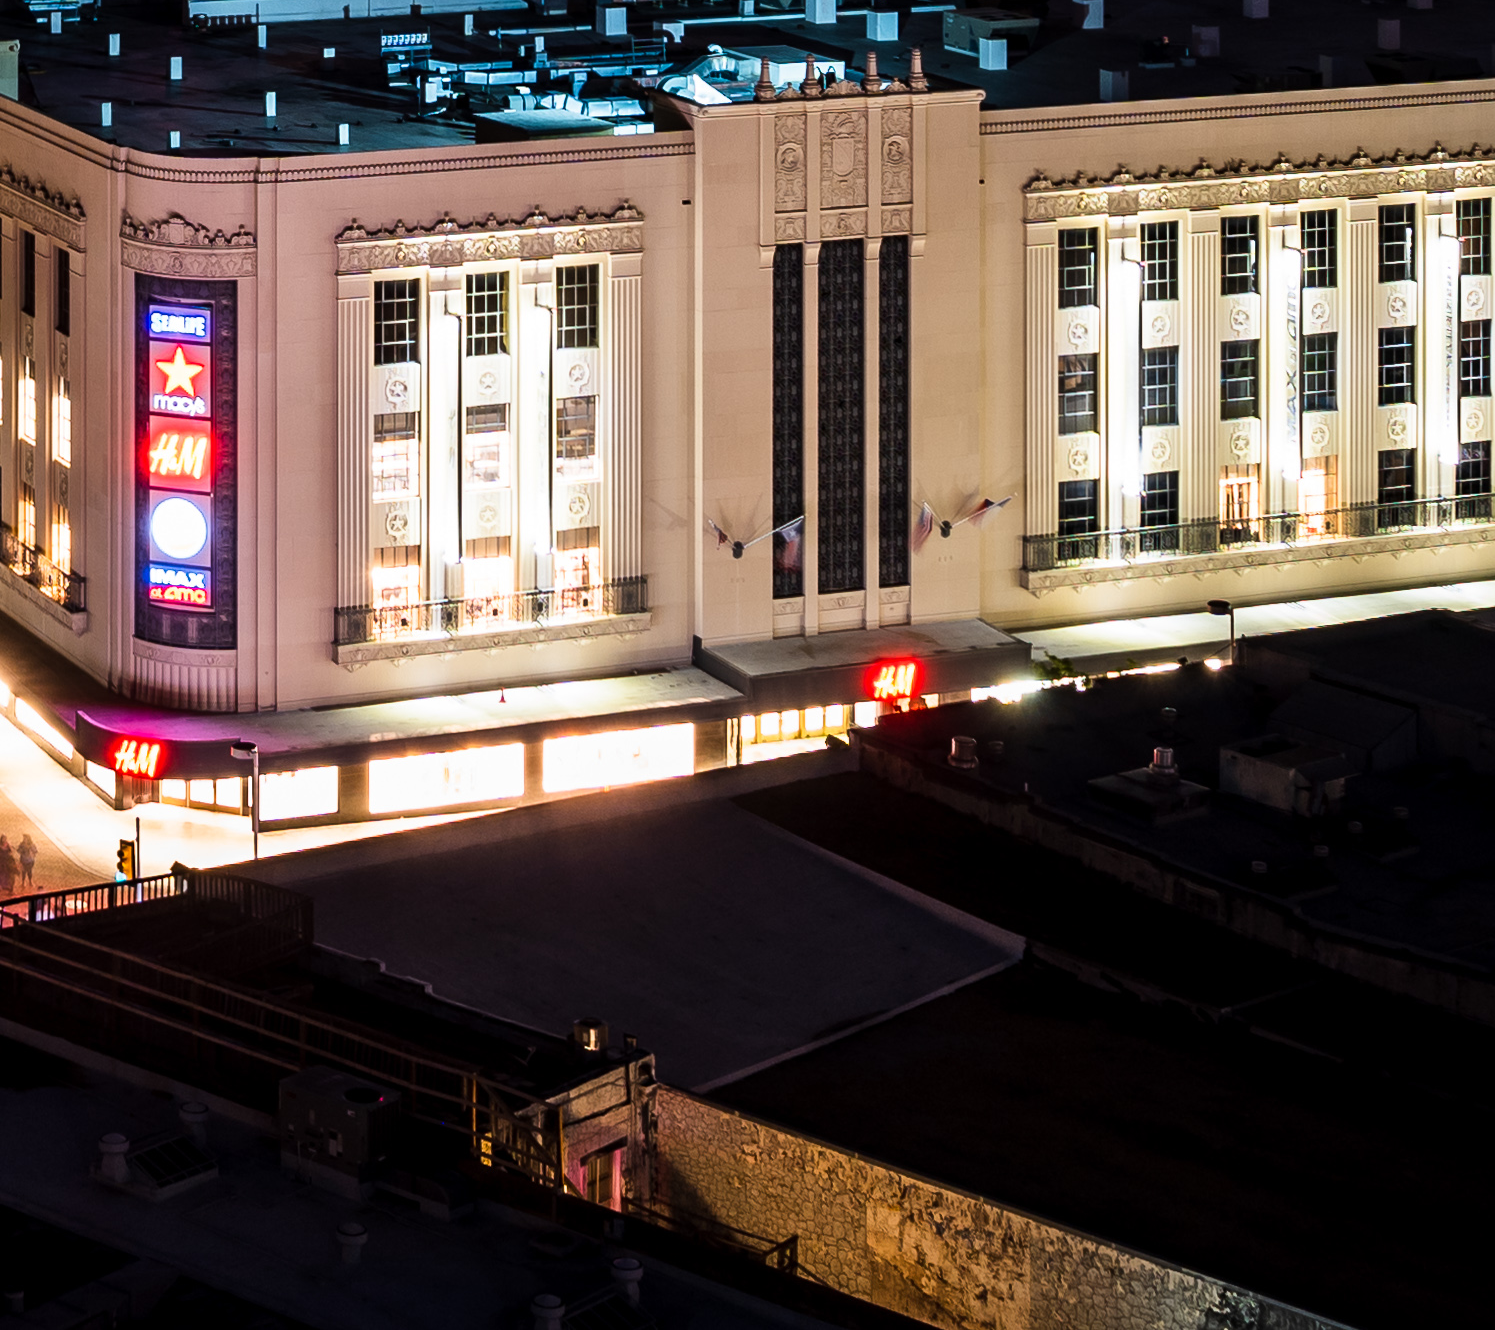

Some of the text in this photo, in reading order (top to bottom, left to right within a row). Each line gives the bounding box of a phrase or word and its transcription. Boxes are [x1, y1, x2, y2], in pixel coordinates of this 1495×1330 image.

[149, 432, 208, 480] H&M
[150, 567, 205, 589] IMAX
[150, 587, 163, 600] at
[872, 662, 916, 699] H&M
[114, 739, 160, 778] H&M
